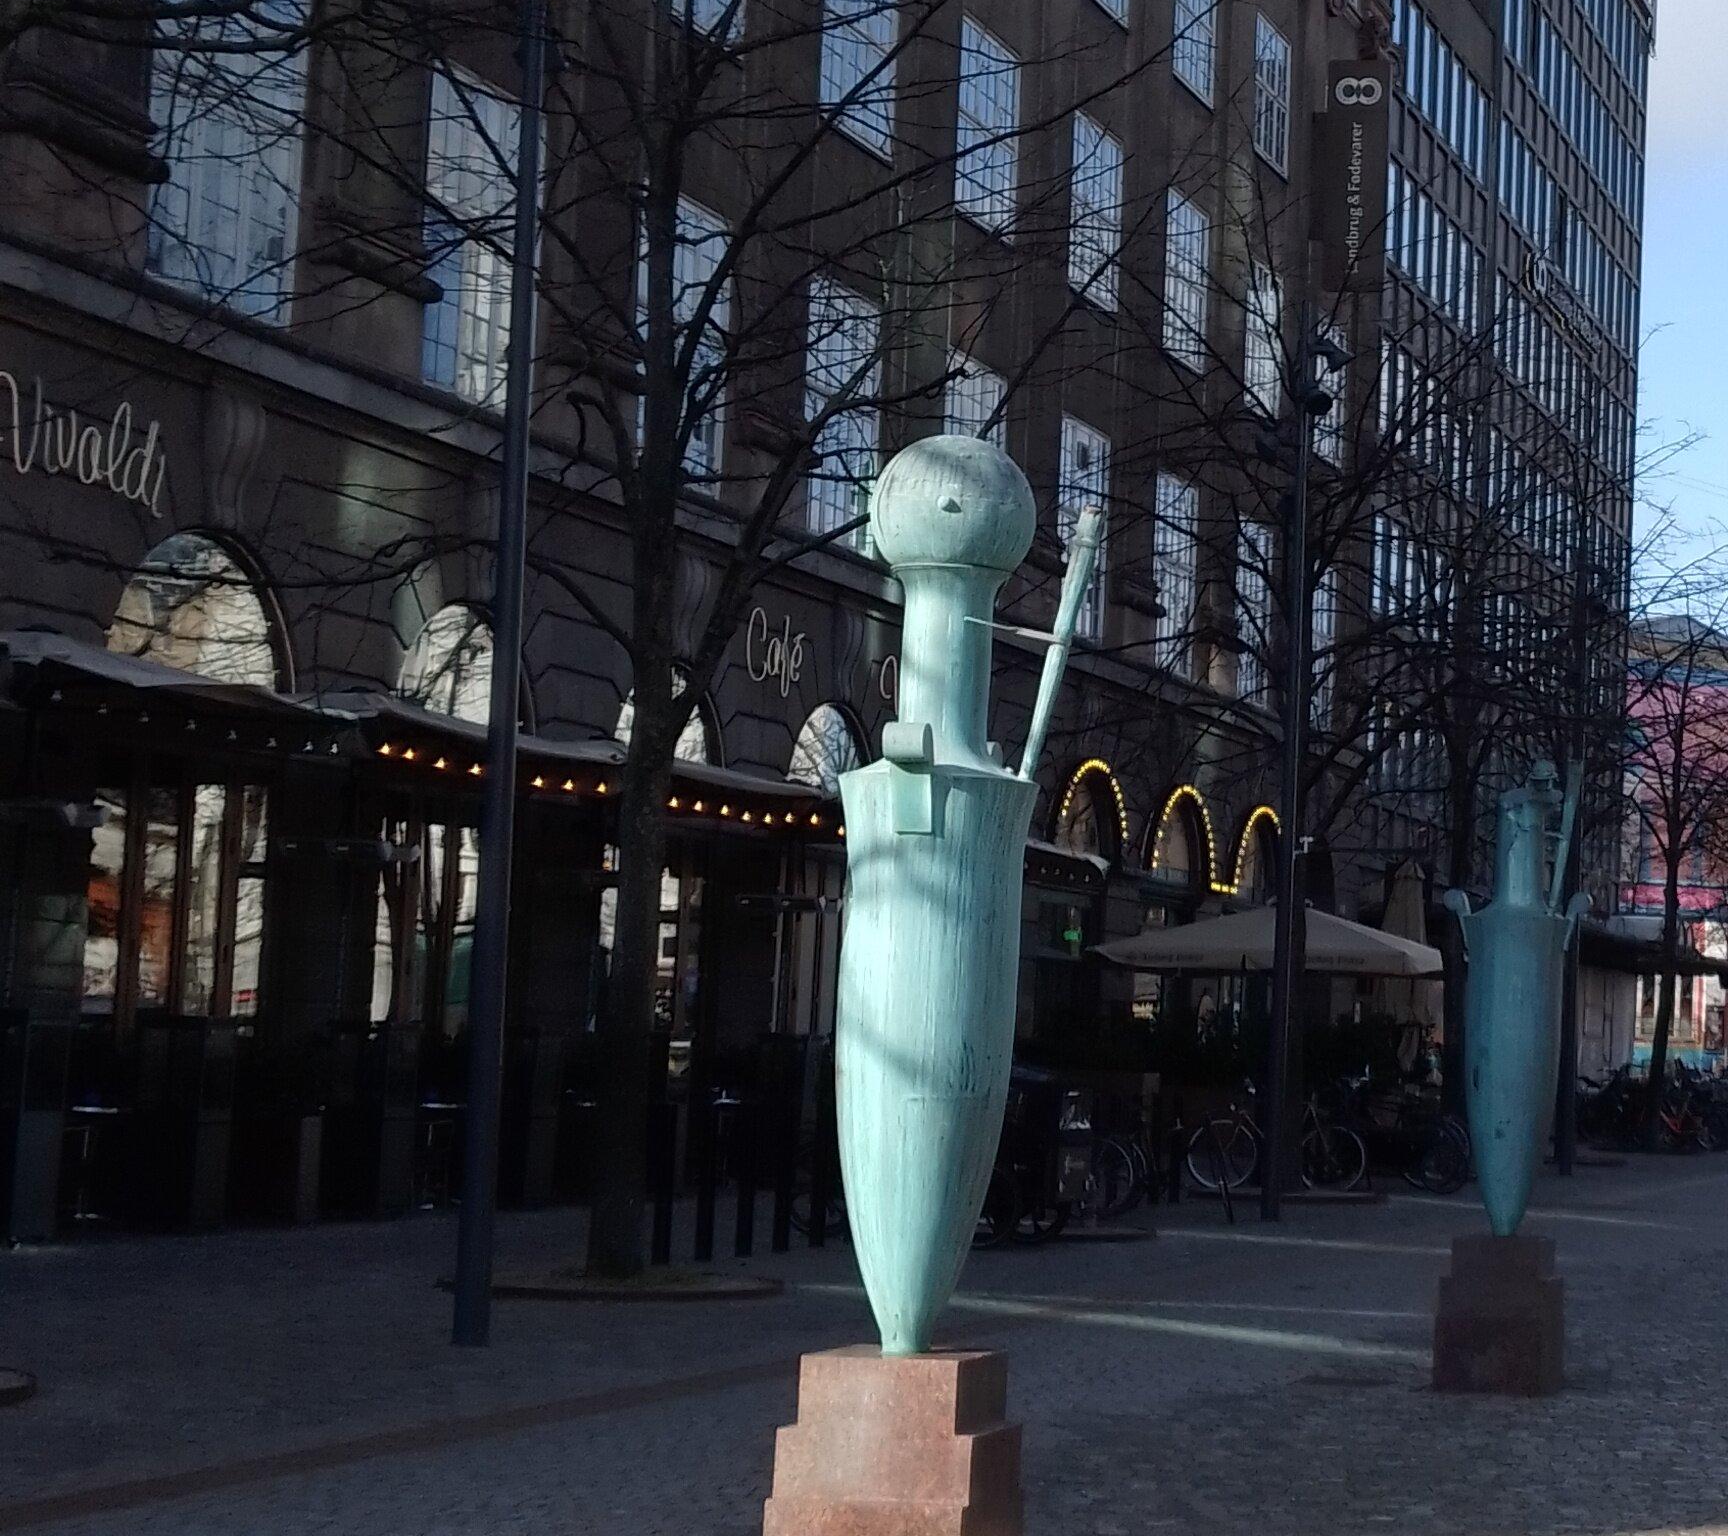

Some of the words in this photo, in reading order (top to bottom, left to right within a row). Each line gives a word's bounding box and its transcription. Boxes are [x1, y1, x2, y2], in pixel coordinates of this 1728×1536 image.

[1347, 195, 1360, 205] &
[0, 369, 166, 518] Vivaldi
[747, 606, 806, 698] Café
